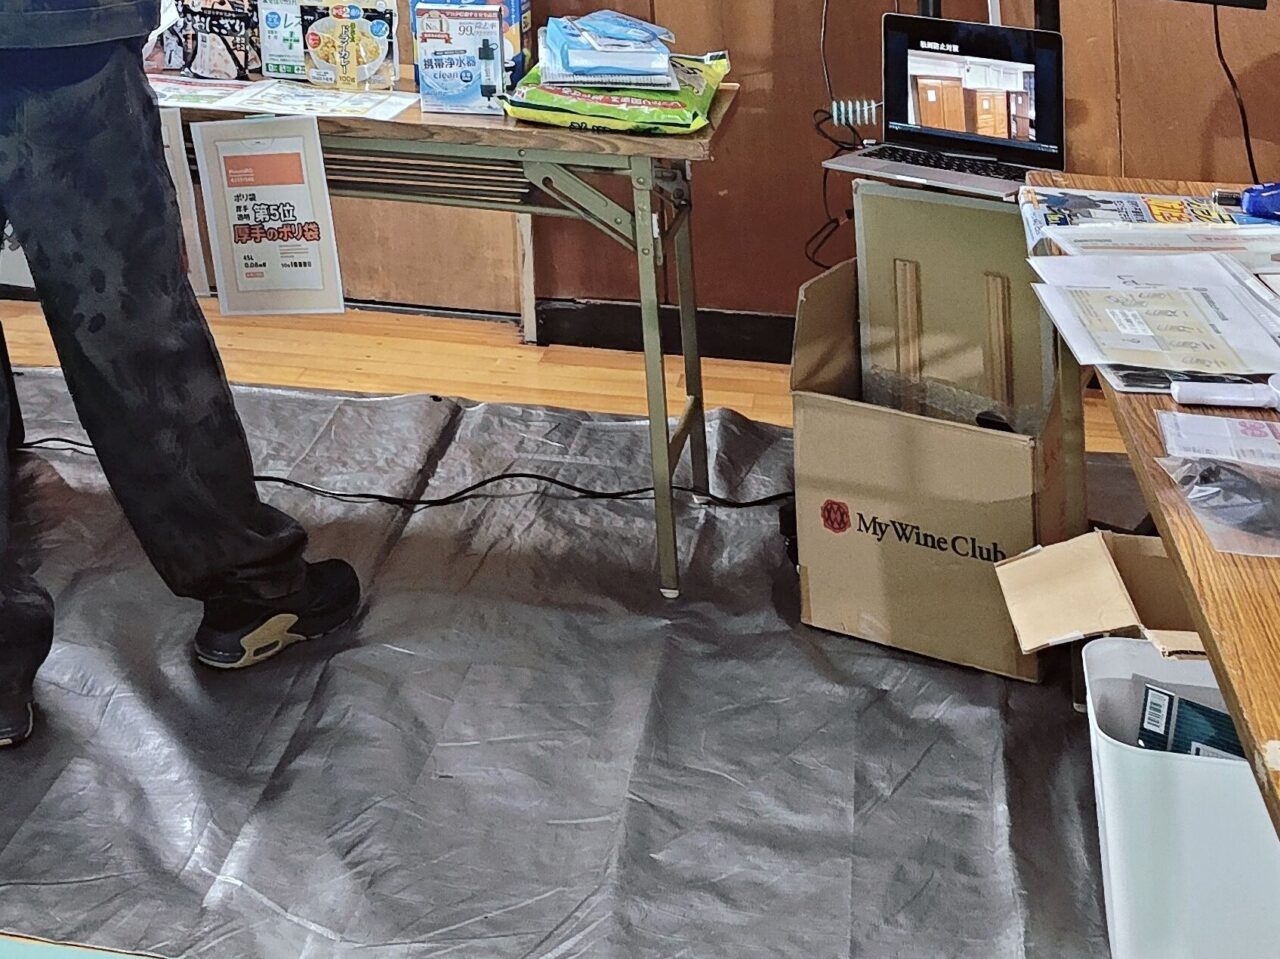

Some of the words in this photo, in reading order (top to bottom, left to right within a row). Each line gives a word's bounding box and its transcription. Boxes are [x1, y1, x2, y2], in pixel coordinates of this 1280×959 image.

[192, 13, 247, 37] おにぎり
[338, 24, 351, 75] ドライカレー
[423, 55, 477, 70] 携帯浄水器
[433, 71, 460, 81] clean
[252, 202, 297, 223] 第5位
[233, 221, 321, 244] 厚手のポリ袋
[856, 512, 891, 543] My
[890, 519, 949, 552] Wine
[950, 534, 1008, 564] Club
